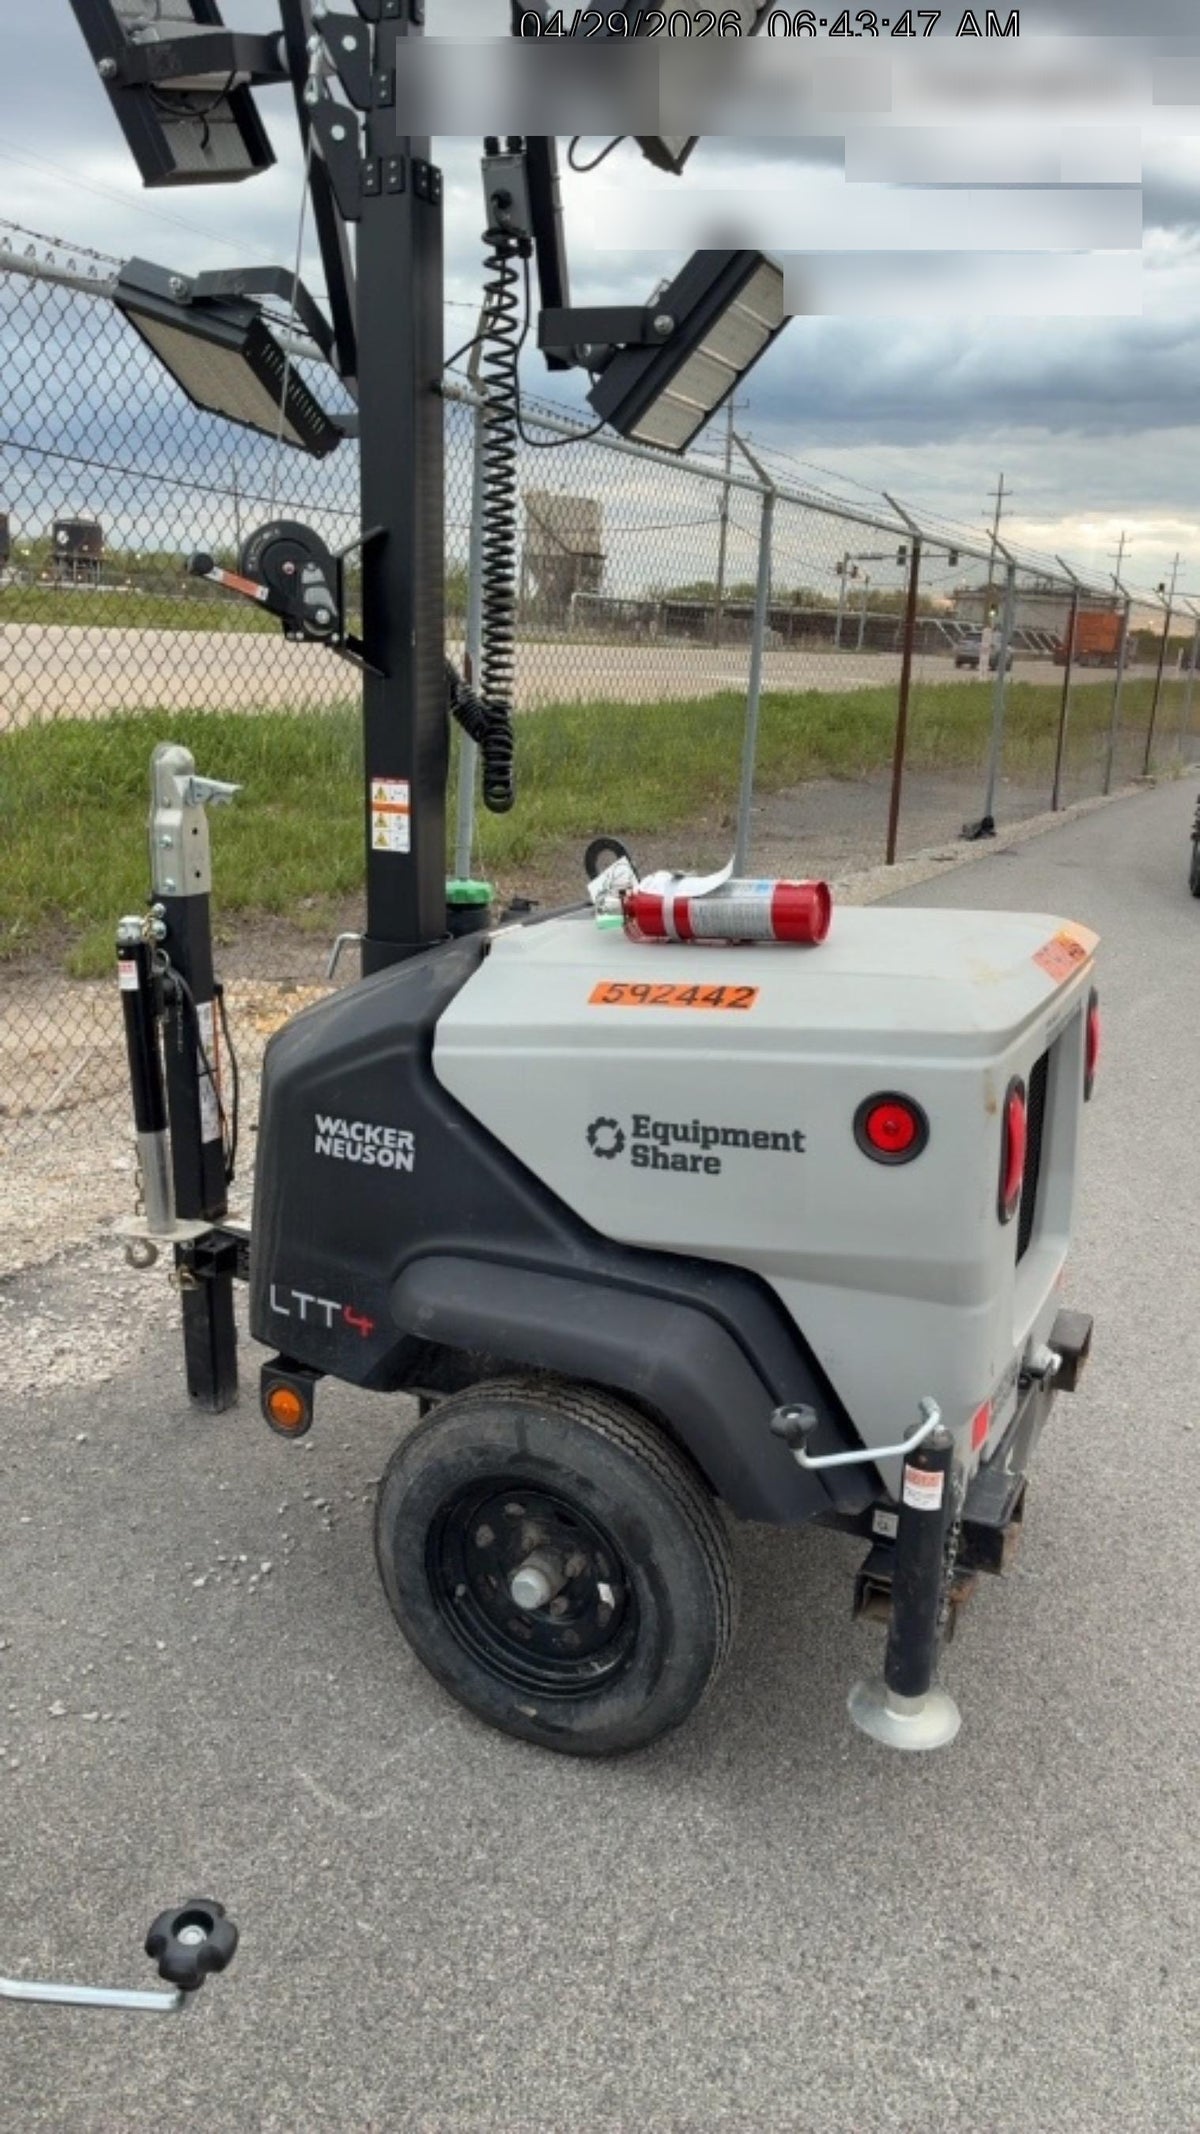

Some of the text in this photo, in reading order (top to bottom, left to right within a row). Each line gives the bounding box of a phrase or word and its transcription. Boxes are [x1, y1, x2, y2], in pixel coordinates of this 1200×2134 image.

[601, 983, 755, 1008] 592442
[315, 1113, 415, 1151] WACKER
[631, 1114, 806, 1153] Equipment
[314, 1134, 414, 1172] NEUSON
[630, 1144, 721, 1175] Share
[270, 1284, 374, 1337] LTT4
